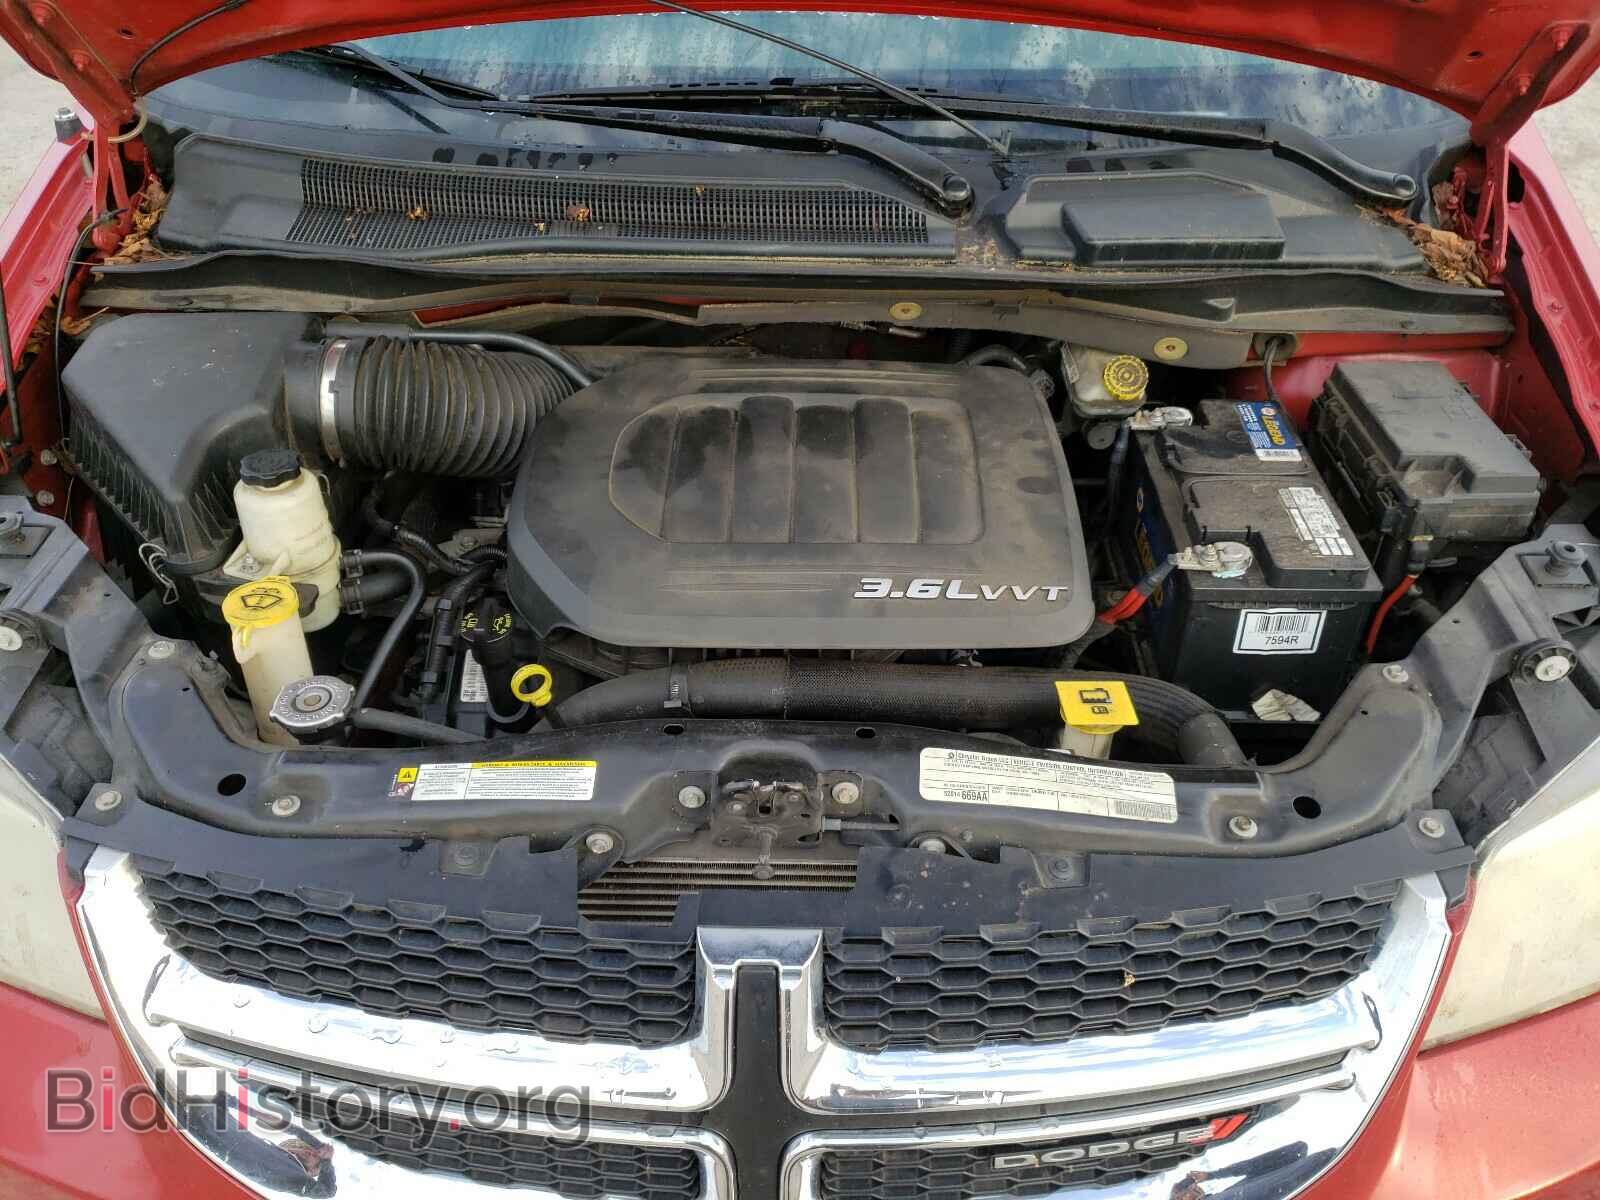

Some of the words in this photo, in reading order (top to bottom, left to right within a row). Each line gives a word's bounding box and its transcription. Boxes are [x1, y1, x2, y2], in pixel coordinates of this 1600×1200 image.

[1261, 415, 1286, 446] LEGEND
[1264, 635, 1299, 646] 7594R
[961, 790, 988, 802] 669AA
[992, 1126, 1214, 1170] DODGE
